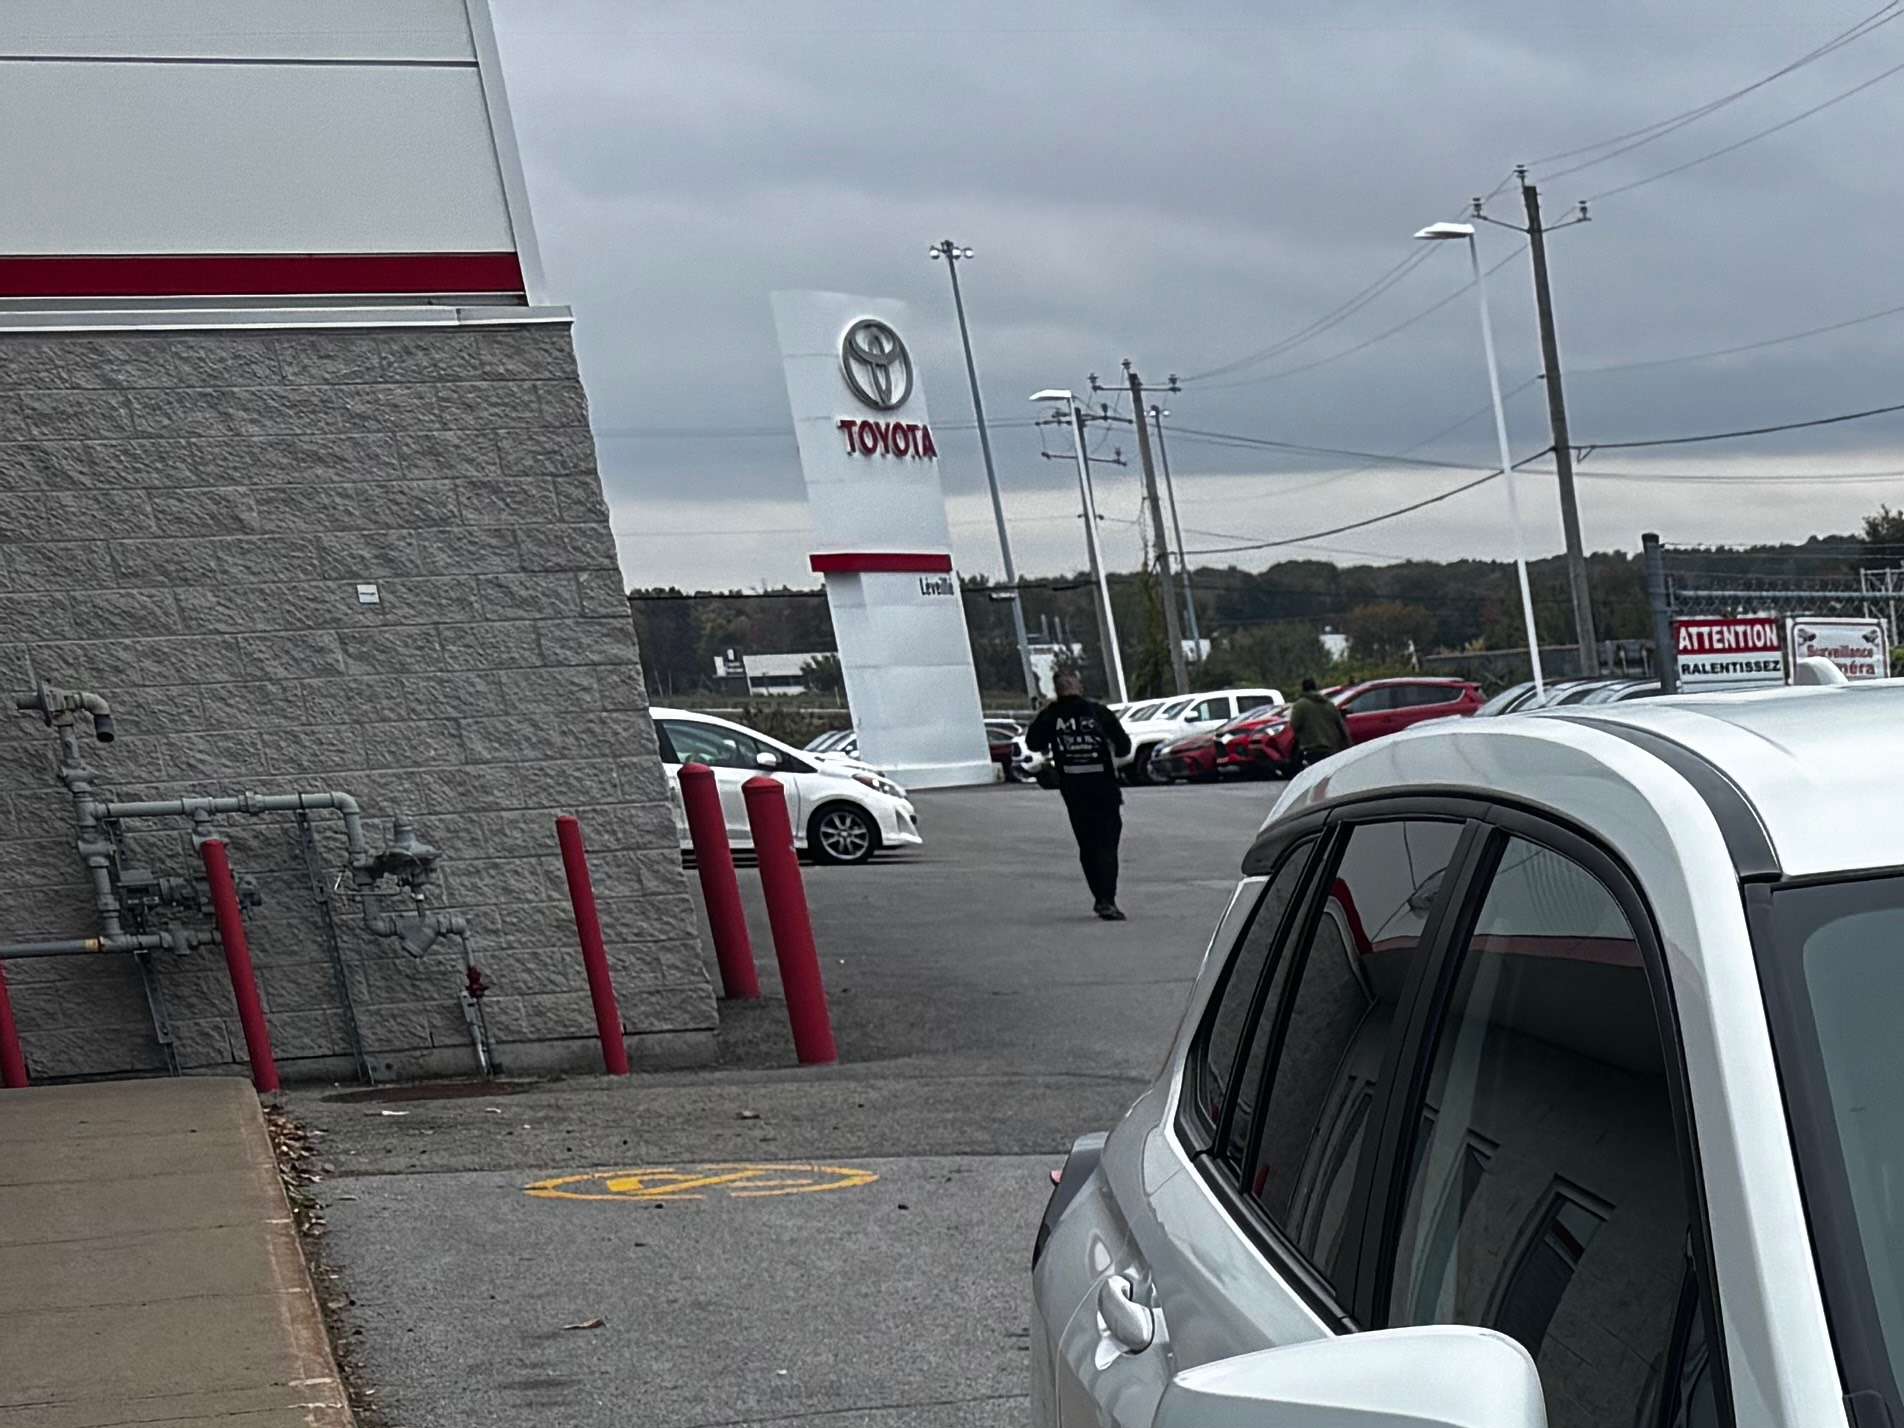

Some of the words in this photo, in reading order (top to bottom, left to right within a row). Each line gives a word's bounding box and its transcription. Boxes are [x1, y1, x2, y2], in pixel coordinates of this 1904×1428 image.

[837, 419, 938, 459] TOYOTA
[1679, 623, 1778, 650] ATTENTION
[1681, 660, 1781, 675] RALENTISSEZ
